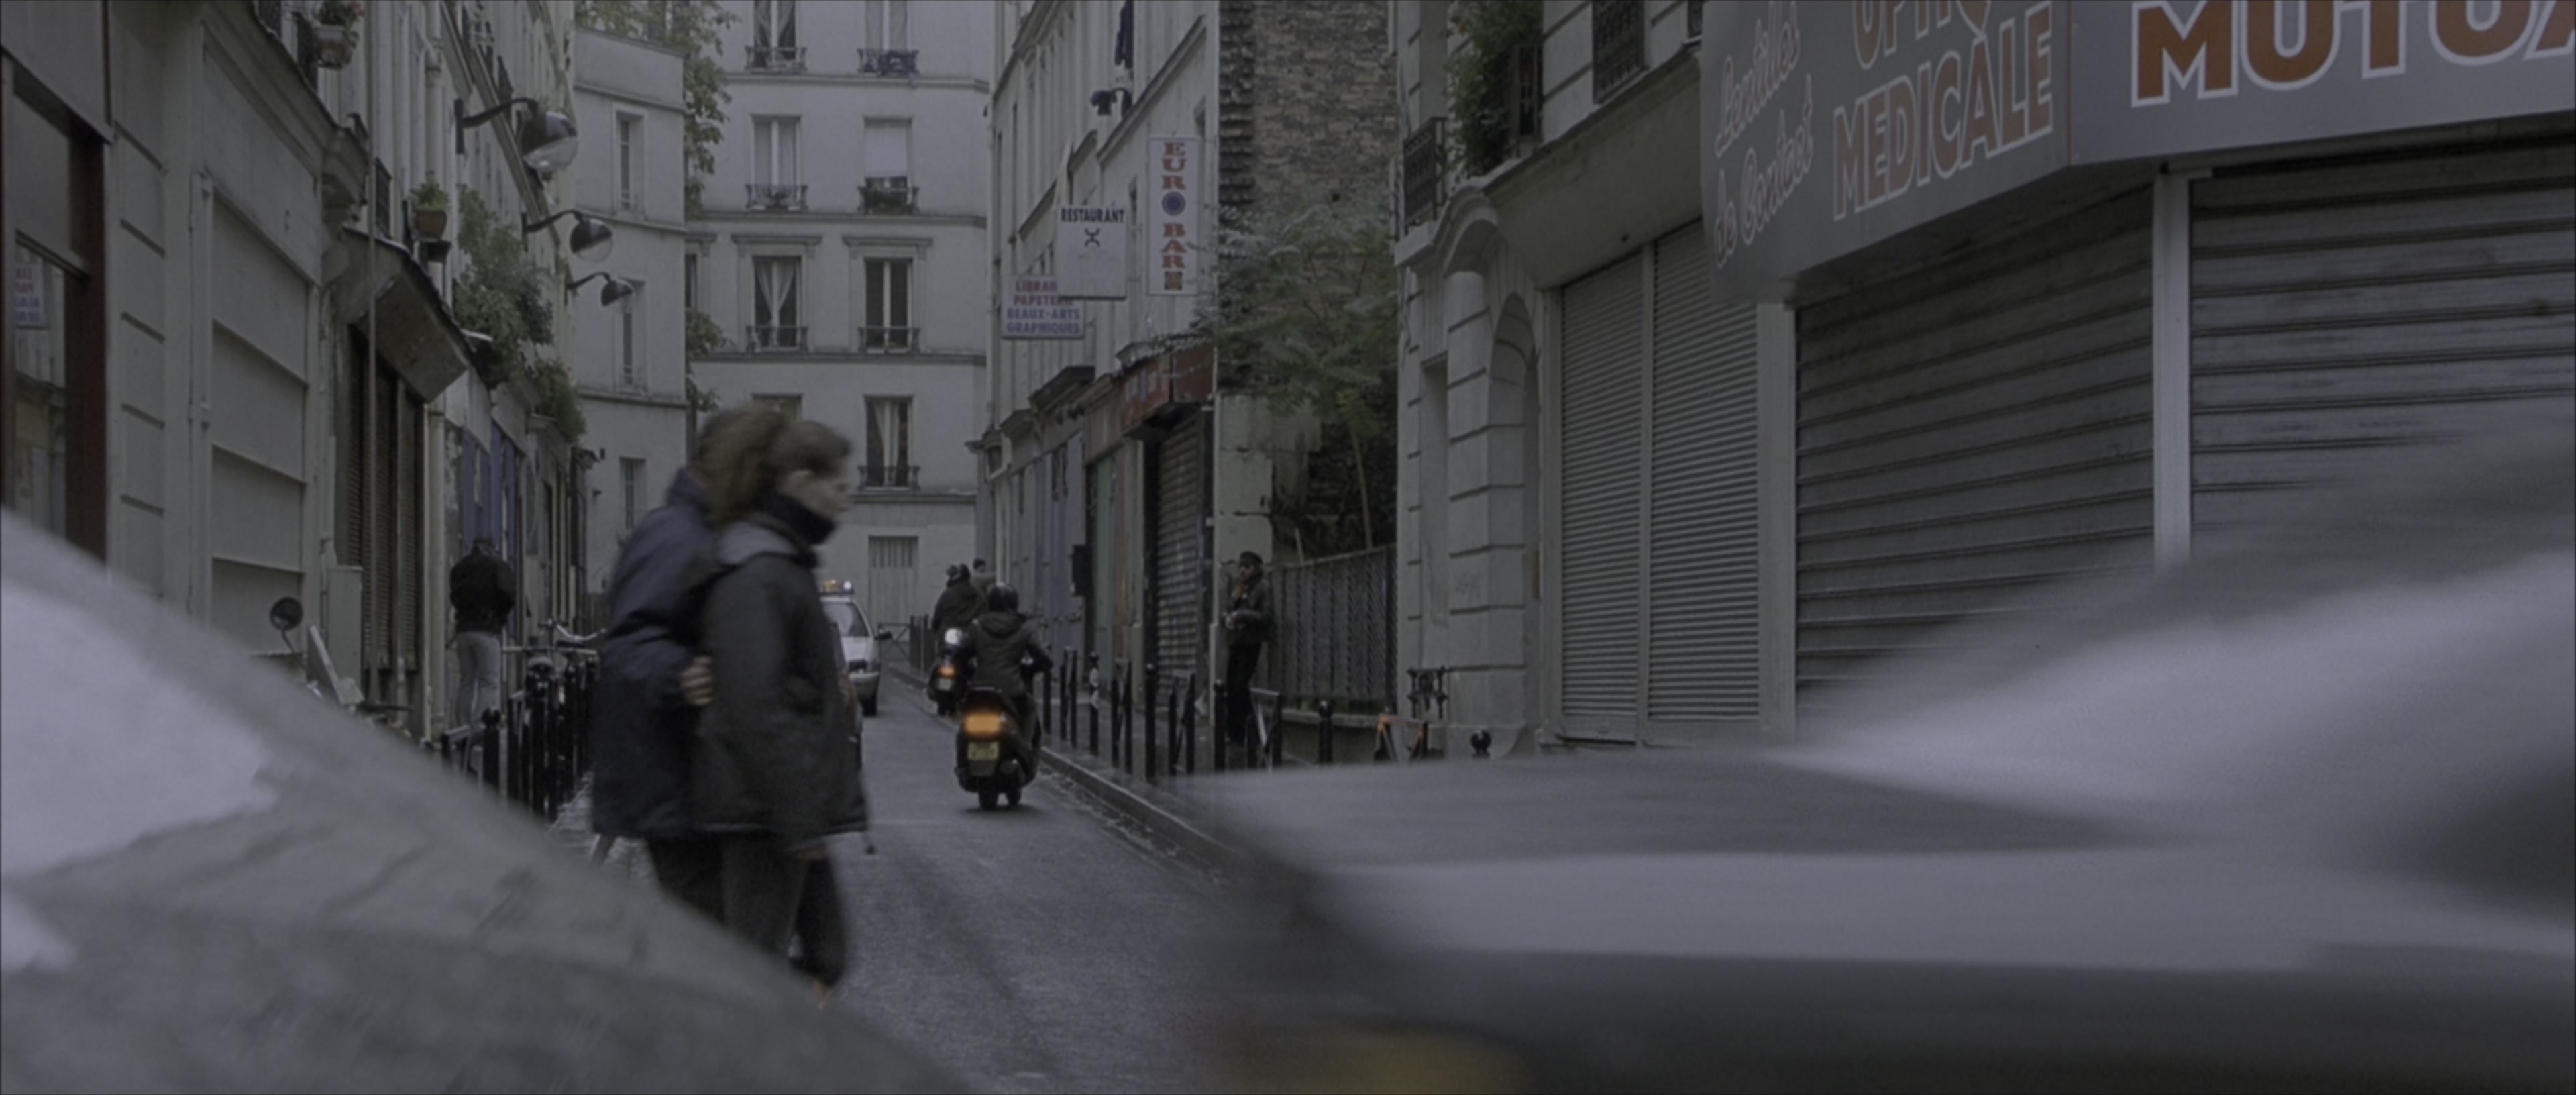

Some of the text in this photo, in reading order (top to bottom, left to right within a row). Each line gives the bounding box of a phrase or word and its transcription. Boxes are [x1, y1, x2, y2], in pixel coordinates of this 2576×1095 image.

[1833, 1, 2053, 221] MEDICALE
[1714, 73, 1813, 269] de Contact
[1061, 208, 1124, 223] RESTAURANT
[1161, 223, 1187, 269] BAR
[1007, 308, 1080, 319] BEAUX-ARTS
[1007, 322, 1080, 333] GRAPHIQUES
